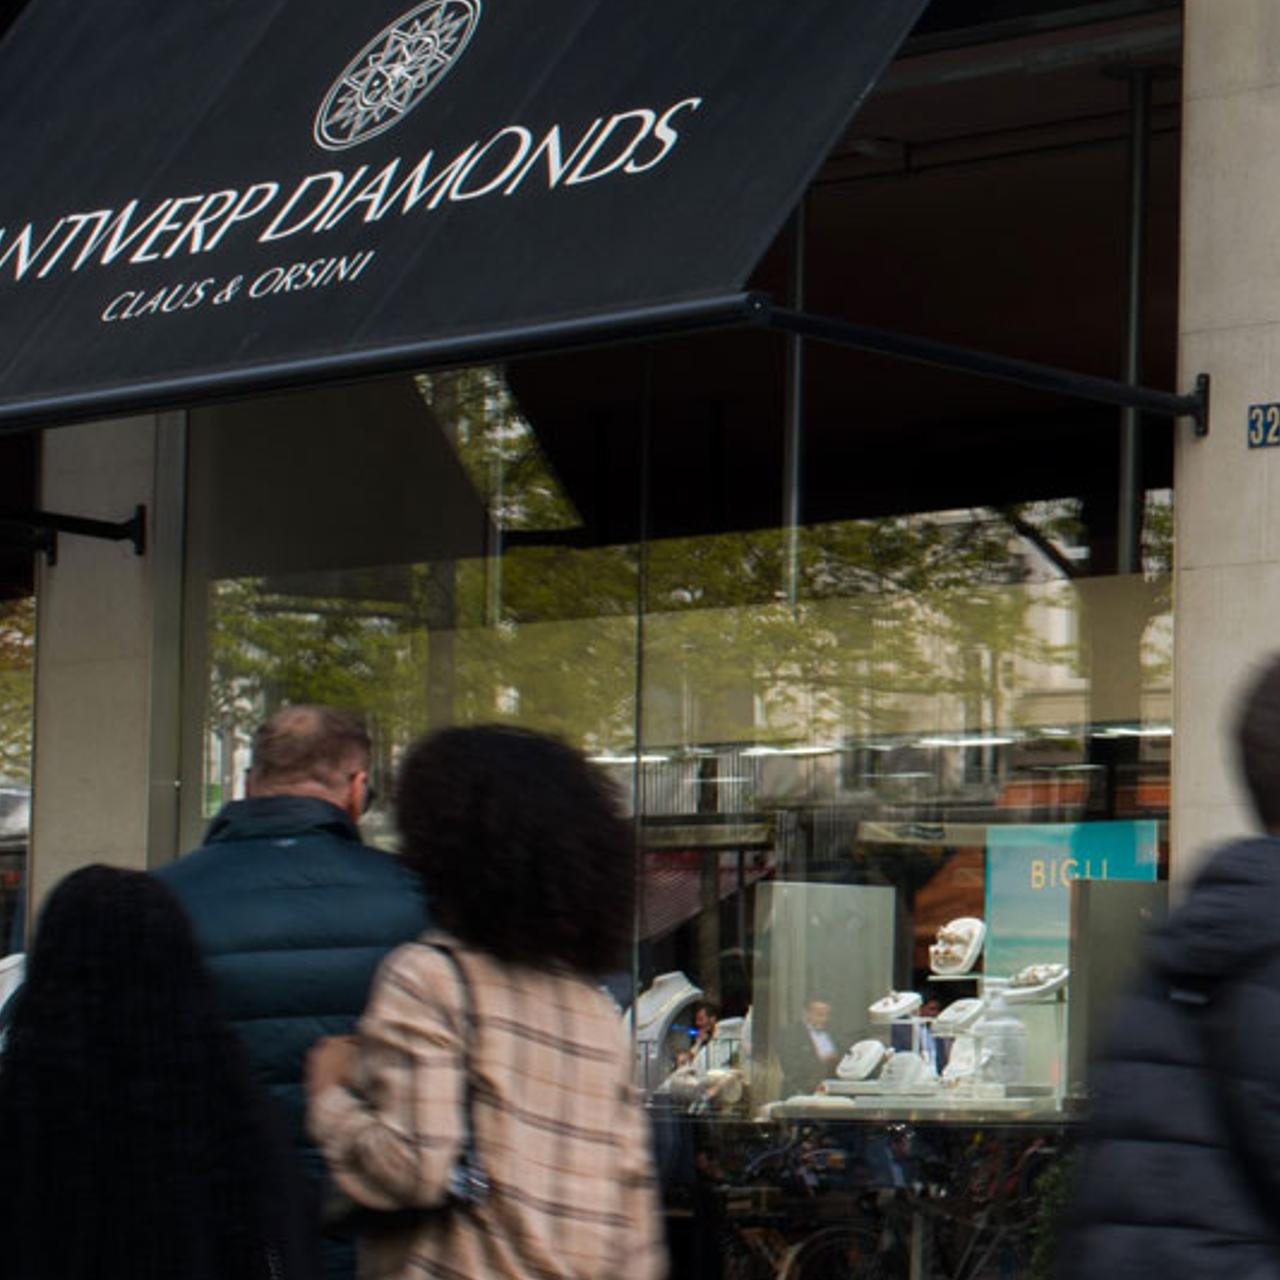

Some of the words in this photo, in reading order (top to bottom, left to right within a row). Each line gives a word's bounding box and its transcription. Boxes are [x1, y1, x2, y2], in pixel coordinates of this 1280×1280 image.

[0, 182, 279, 281] NTWERP
[257, 97, 702, 243] DIAMONDS
[101, 278, 215, 321] CLAUS
[212, 275, 243, 304] &
[249, 250, 375, 298] ORSINI
[1251, 407, 1280, 444] 32
